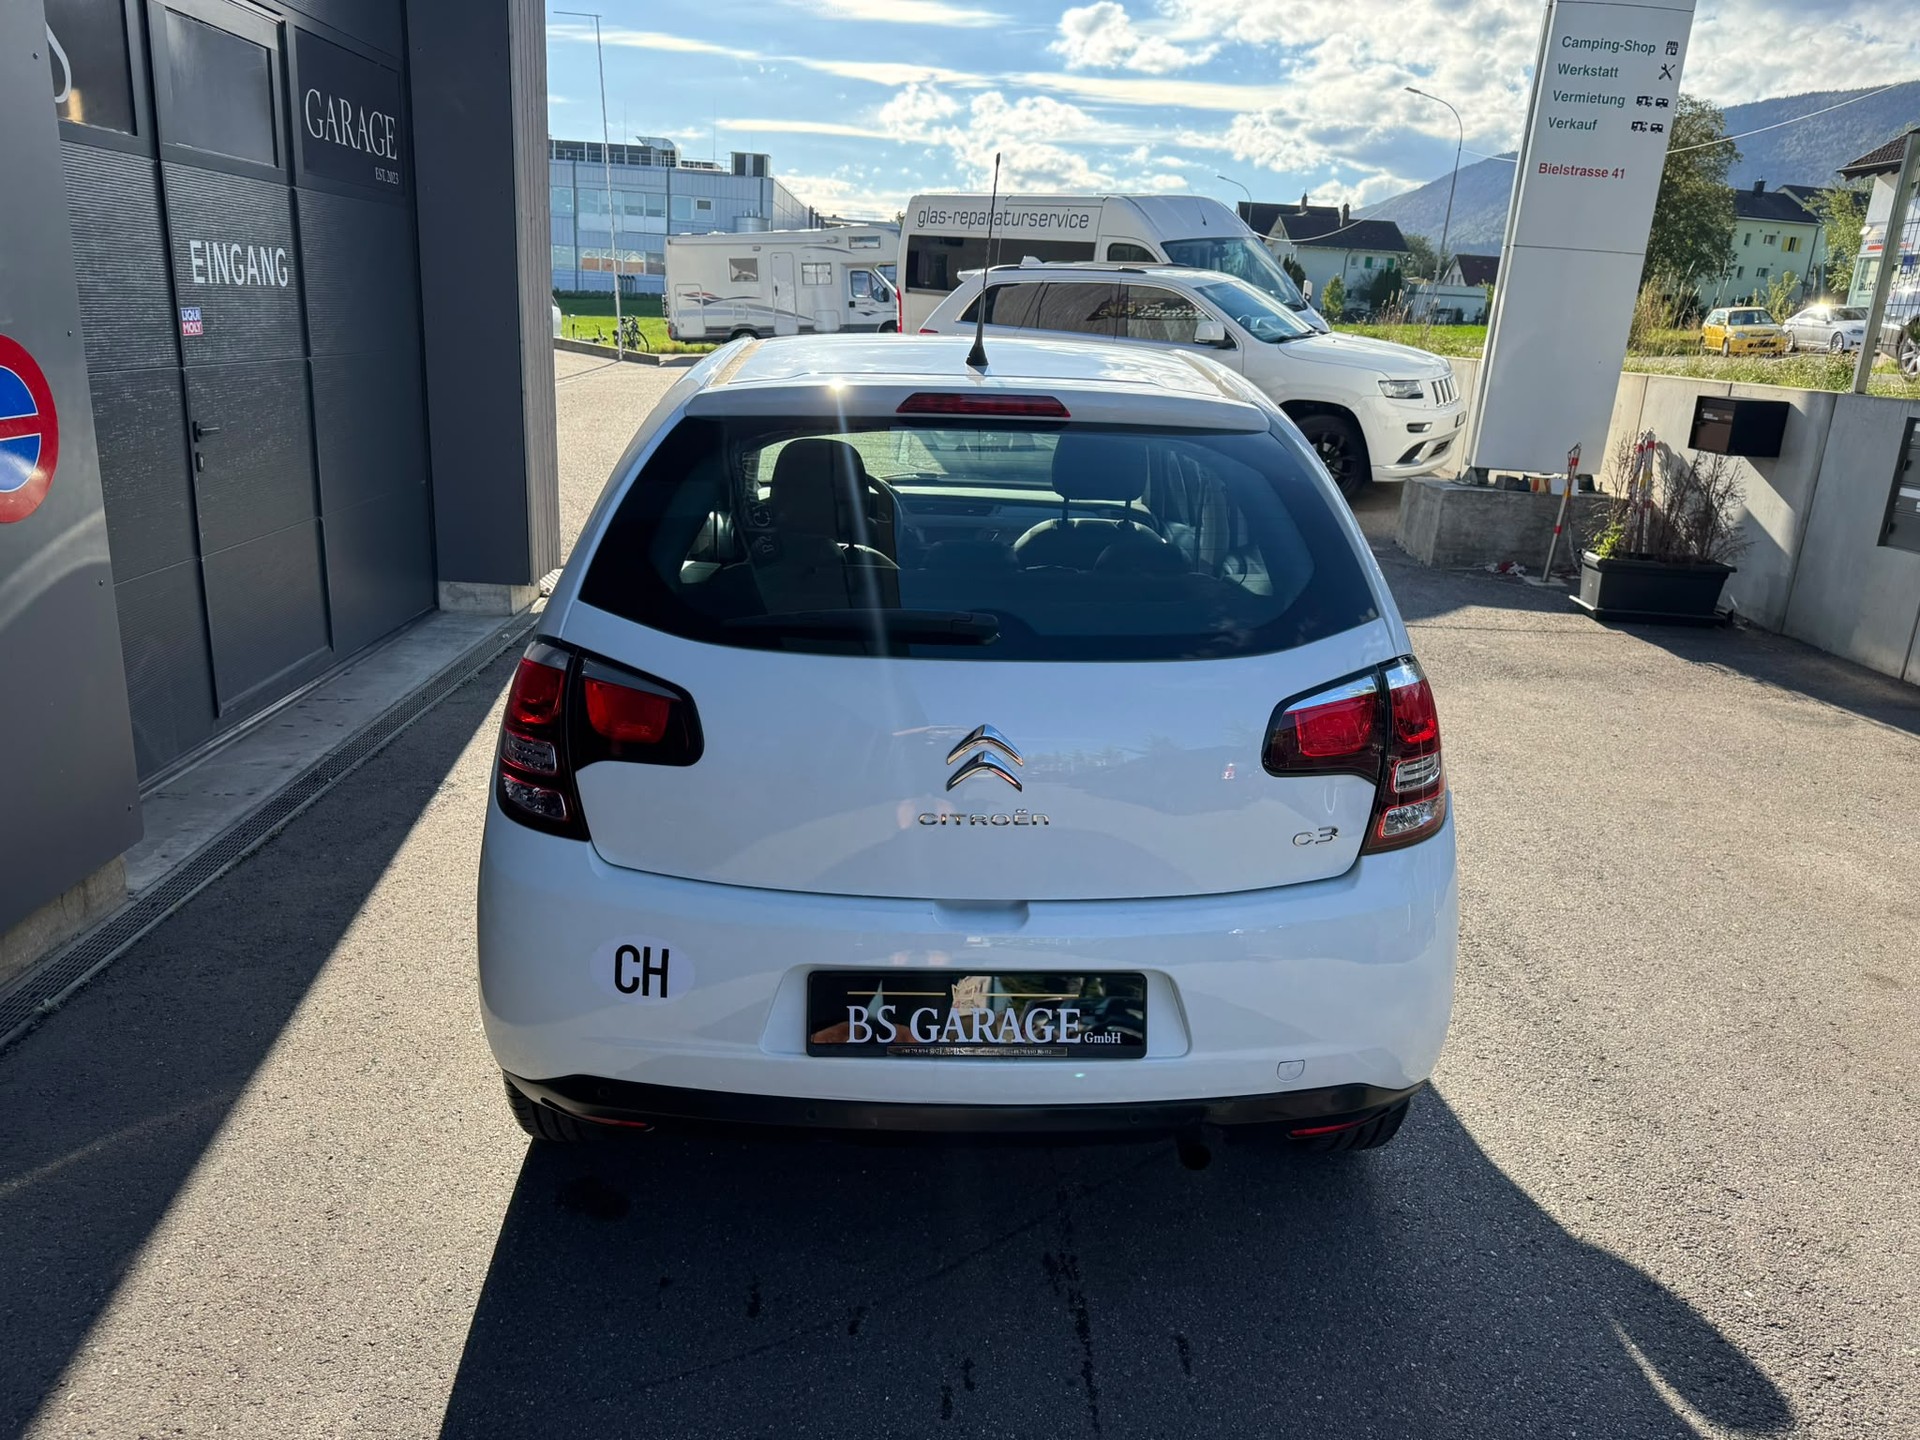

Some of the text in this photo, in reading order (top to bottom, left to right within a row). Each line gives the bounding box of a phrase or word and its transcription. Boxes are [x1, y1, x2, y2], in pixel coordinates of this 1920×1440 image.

[1562, 36, 1656, 56] Camping-Shop
[1558, 63, 1619, 78] Werkstatt
[1553, 90, 1626, 108] Vermietung
[305, 88, 398, 160] GARAGE
[1548, 117, 1598, 131] Verkauf
[1538, 163, 1626, 179] Bielstrasse 41
[917, 206, 1090, 229] glas-reparaturservice
[190, 240, 288, 287] EINGANG
[182, 321, 202, 334] MOLY
[918, 808, 1050, 826] CITROËN
[1292, 826, 1339, 846] C3
[614, 944, 669, 998] CH
[846, 1004, 1122, 1044] BS GARAGE GmbH
